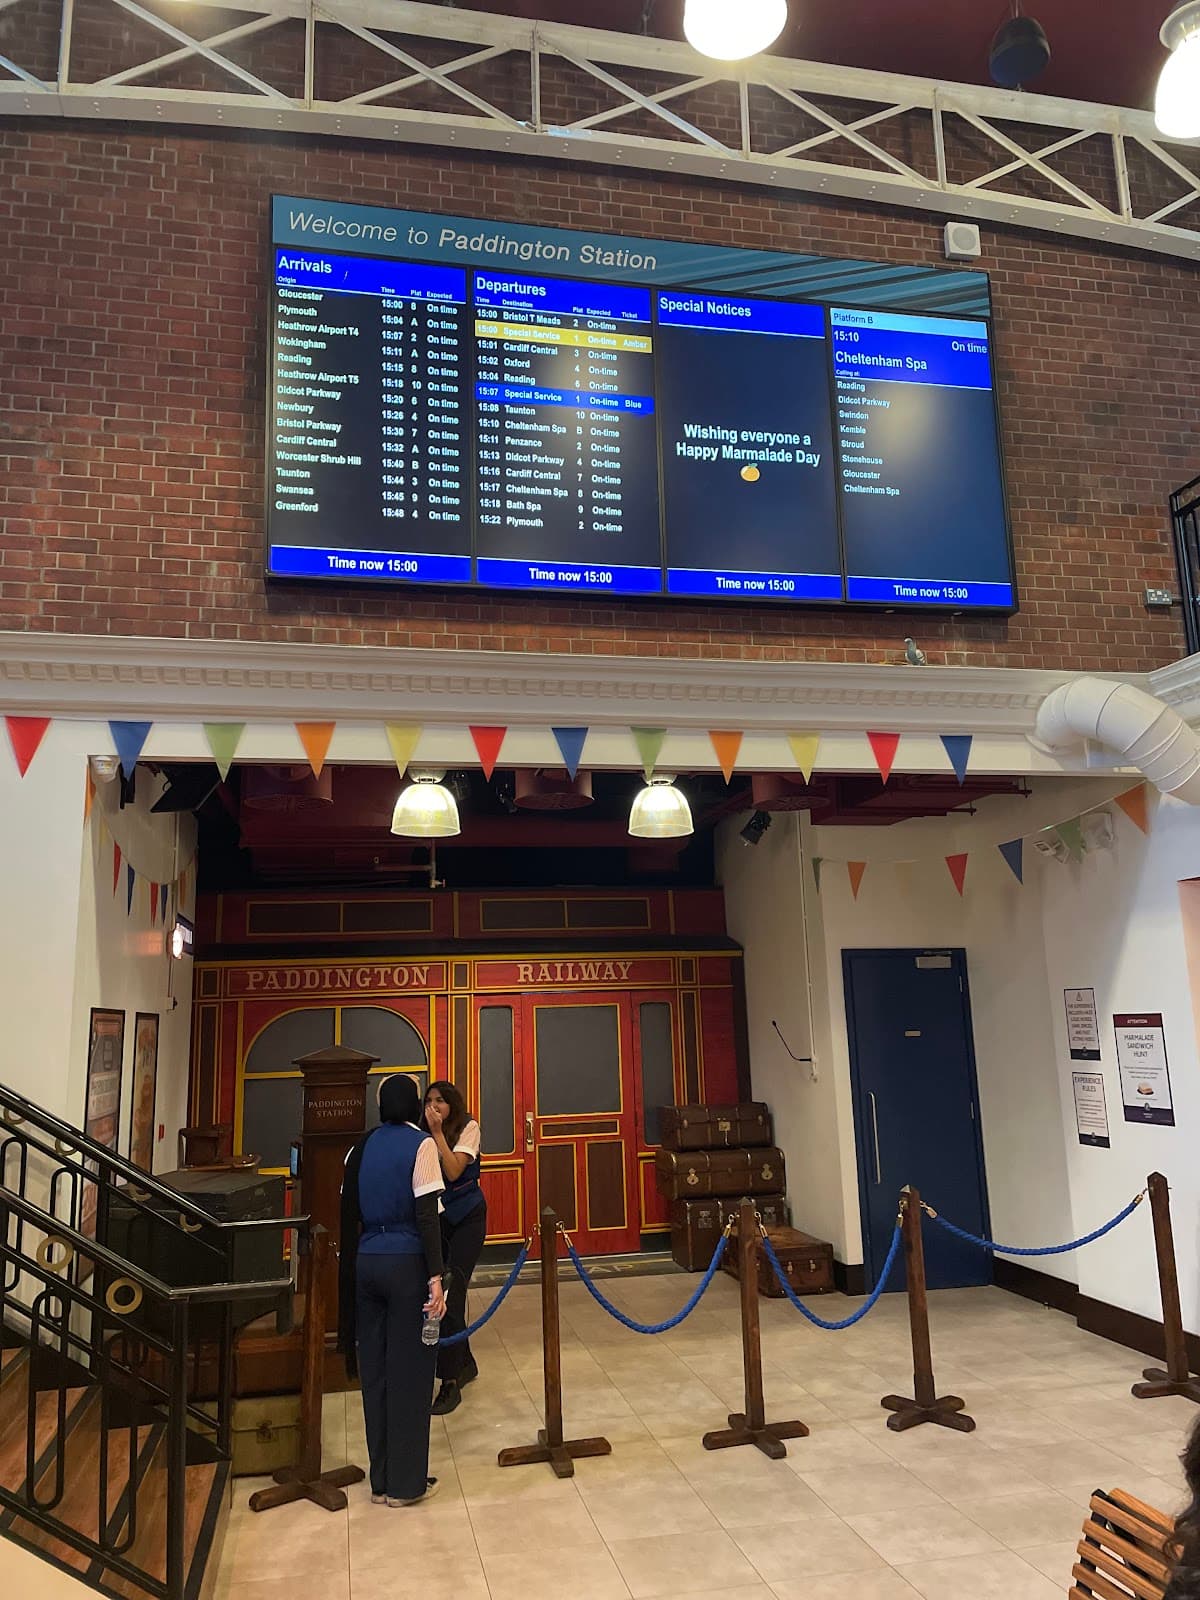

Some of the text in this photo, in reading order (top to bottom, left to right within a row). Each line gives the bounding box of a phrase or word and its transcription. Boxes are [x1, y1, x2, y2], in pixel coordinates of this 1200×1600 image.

[289, 211, 657, 270] Welcome to Paddington Station
[279, 256, 332, 273] Arrivals
[477, 277, 546, 296] Departures
[278, 288, 403, 309] Gloucester 15:00
[660, 298, 752, 317] Special Notices
[278, 304, 403, 324] Plymouth 15:04
[477, 308, 498, 318] 15:00
[503, 311, 528, 321] Bristol
[529, 314, 535, 322] T
[587, 320, 616, 330] On-time
[834, 312, 866, 323] Platform
[278, 320, 403, 340] Heathrow Airport T4 15:07
[504, 327, 532, 336] Special
[532, 330, 560, 340] Service
[588, 335, 616, 345] On-time
[277, 335, 402, 356] Wokingham 15:11
[477, 339, 617, 360] 15:01 Cardiff Central On-time
[834, 330, 987, 353] 15:10 On time
[277, 352, 404, 372] Reading 15:15
[478, 355, 617, 376] 15:02 Oxford On-time
[836, 350, 927, 371] Cheltenham Spa
[277, 368, 404, 388] Heathrow Airport T5 15:18
[478, 371, 618, 391] 15:04 Reading On-time
[837, 380, 866, 392] Reading
[277, 384, 404, 404] Didcot Parkway 15:20
[478, 386, 642, 408] 15:07 Special Service On-time Blue
[838, 395, 892, 409] Didcot Parkway
[277, 400, 314, 414] Newbury
[478, 402, 619, 422] 15:08 Taunton On-time
[839, 410, 870, 422] Swindon
[276, 417, 404, 436] Bristol Parkway 15:30
[478, 418, 619, 437] 15:10 Cheltenham Spa On-time
[684, 424, 811, 446] Wishing everyone a
[840, 424, 866, 434] Kemble
[276, 434, 404, 452] Cardiff Central 15:32
[479, 434, 620, 453] 15:11 Penzance On-time
[841, 439, 864, 448] Stroud
[276, 450, 404, 468] Worcester Shrub Hill 15:40
[479, 450, 620, 468] 15:13 Didcot Parkway On-time
[676, 442, 820, 468] Happy Marmalade Day
[842, 454, 883, 464] Stonehouse
[276, 467, 310, 478] Taunton
[479, 466, 621, 484] 15:16 Cardiff Central On-time
[843, 469, 880, 479] Gloucester
[276, 484, 404, 500] Swansea 15:45
[480, 482, 621, 500] 15:17 Cheltenham Spa On-time
[844, 484, 900, 496] Cheltenham Spa
[275, 500, 318, 512] Greenford
[480, 498, 622, 515] 15:18 Bath Spa On-time
[480, 514, 622, 531] 15:22 Plymouth On-time
[327, 555, 417, 572] Time now 15:00
[529, 567, 612, 583] Time now 15:00
[716, 577, 795, 592] Time now 15:00
[893, 584, 968, 598] Time now 15:00
[246, 966, 430, 990] PADDINGTON
[517, 962, 633, 983] RAILWAY
[308, 1098, 362, 1109] PADDINGTON
[316, 1109, 352, 1118] STATION
